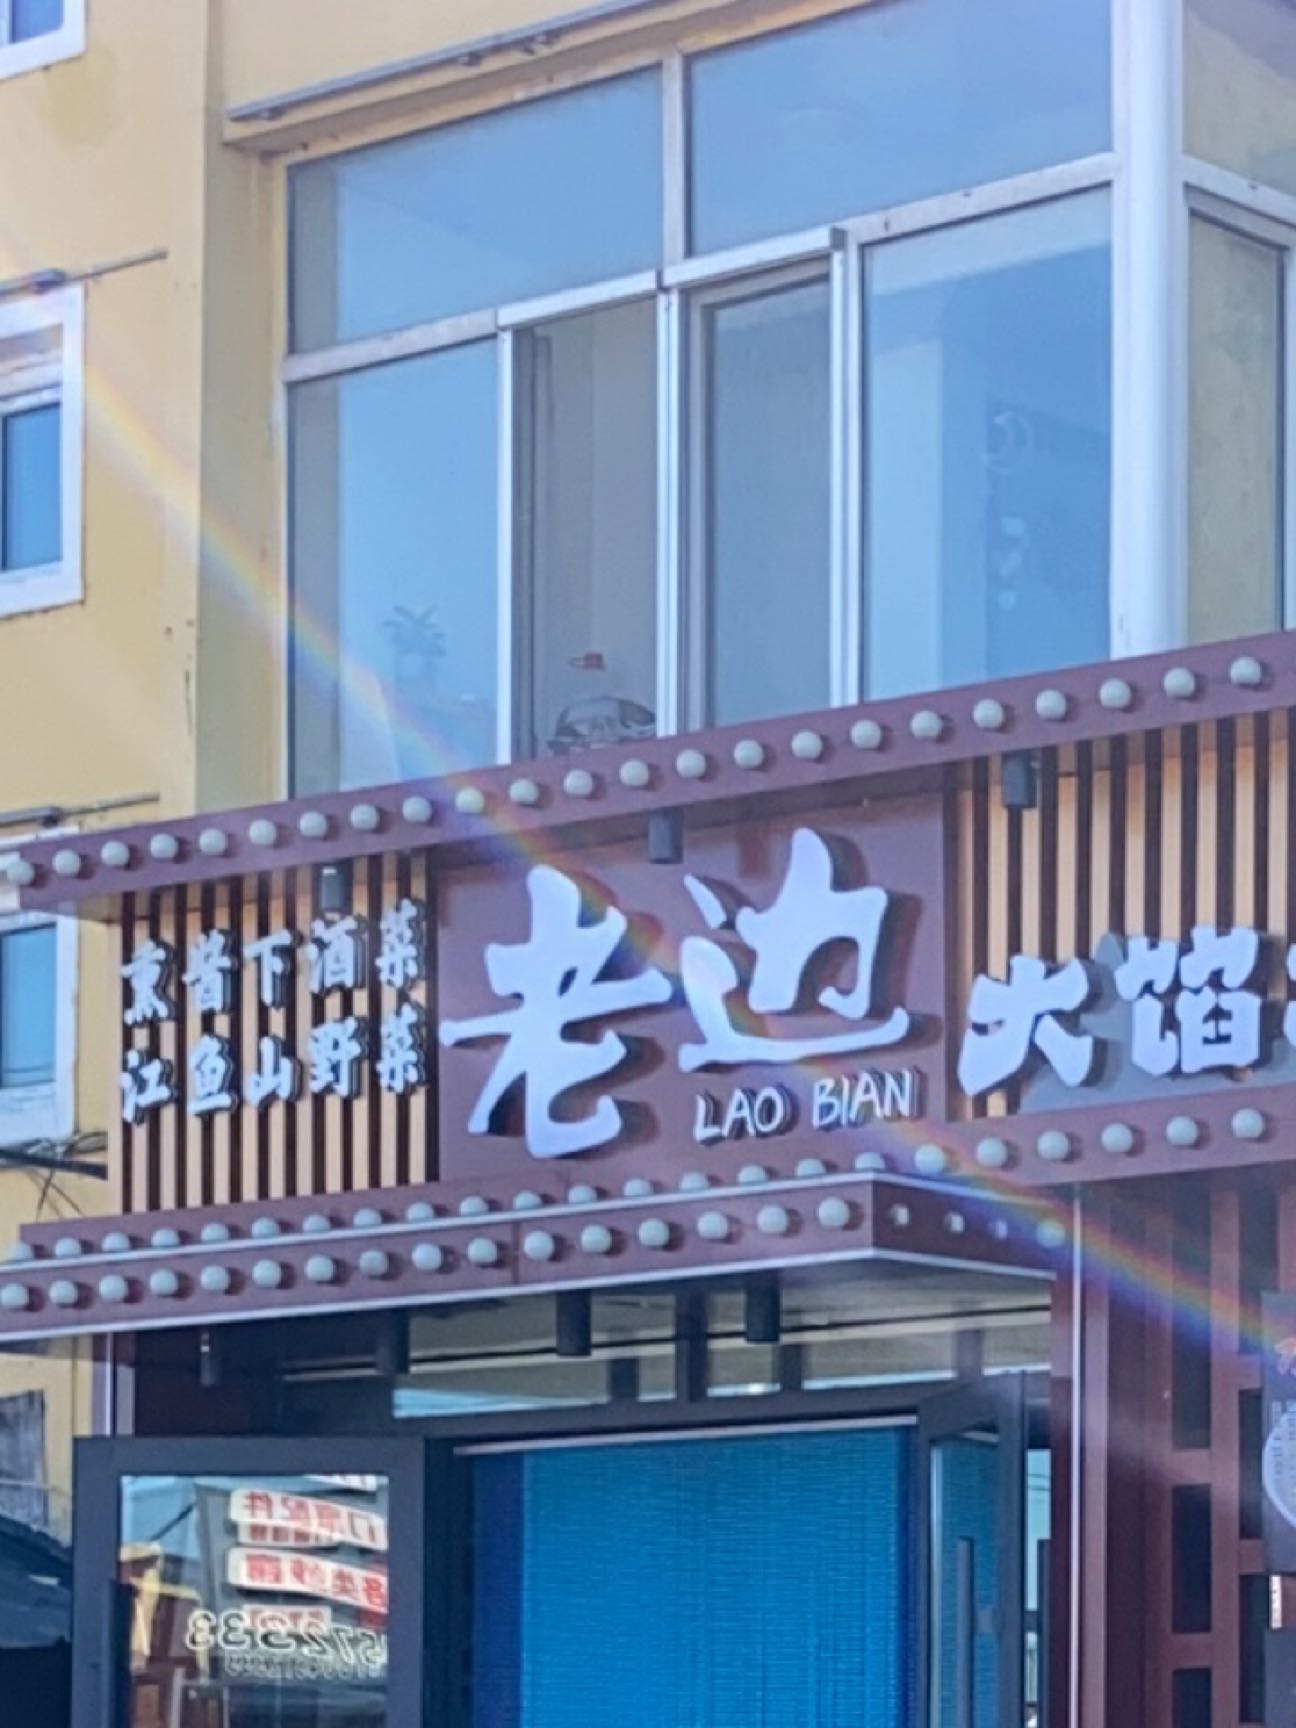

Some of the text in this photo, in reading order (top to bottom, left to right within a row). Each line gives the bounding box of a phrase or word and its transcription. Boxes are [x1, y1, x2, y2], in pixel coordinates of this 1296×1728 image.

[438, 827, 910, 1158] 老边
[121, 1002, 418, 1124] 江鱼山野菜
[694, 1068, 913, 1143] LAO BIAN
